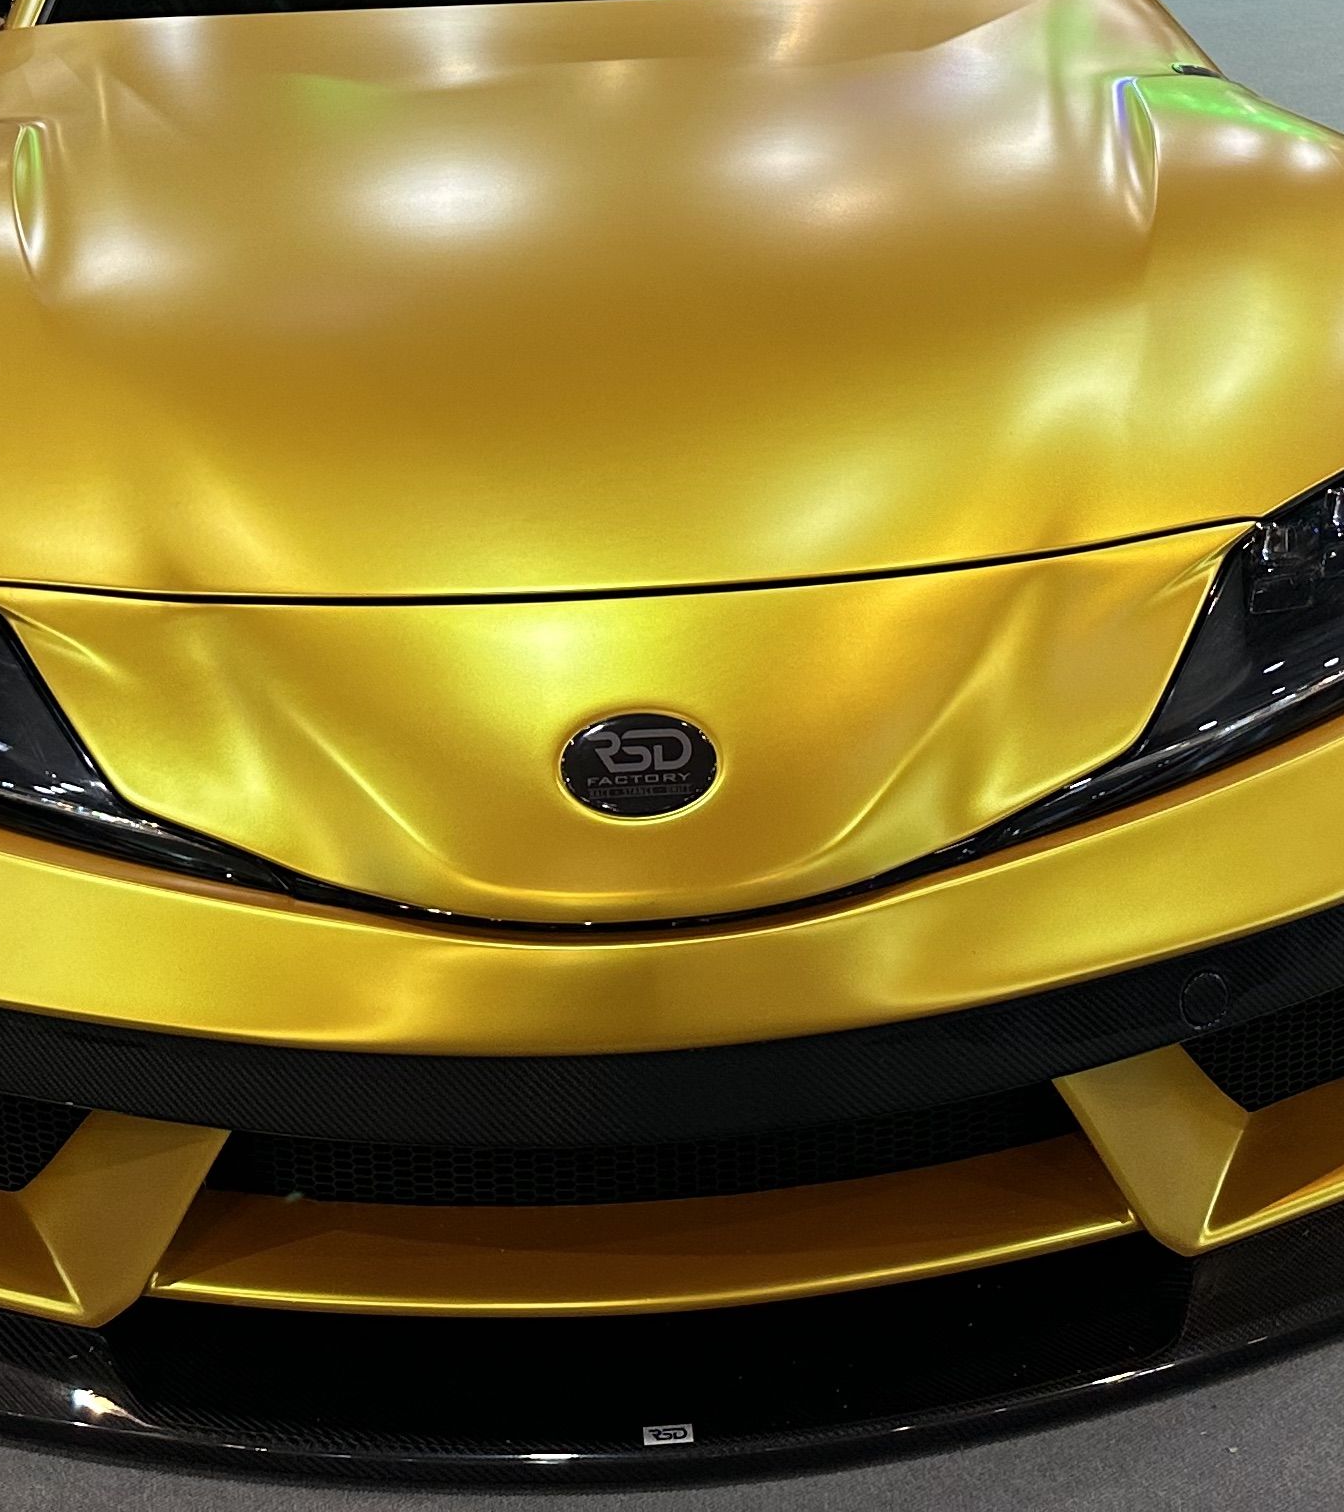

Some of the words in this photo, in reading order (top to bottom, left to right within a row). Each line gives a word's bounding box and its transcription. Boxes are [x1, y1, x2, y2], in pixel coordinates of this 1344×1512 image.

[586, 728, 692, 773] RSD
[587, 772, 691, 786] FACTORY
[648, 1428, 688, 1441] RSD
